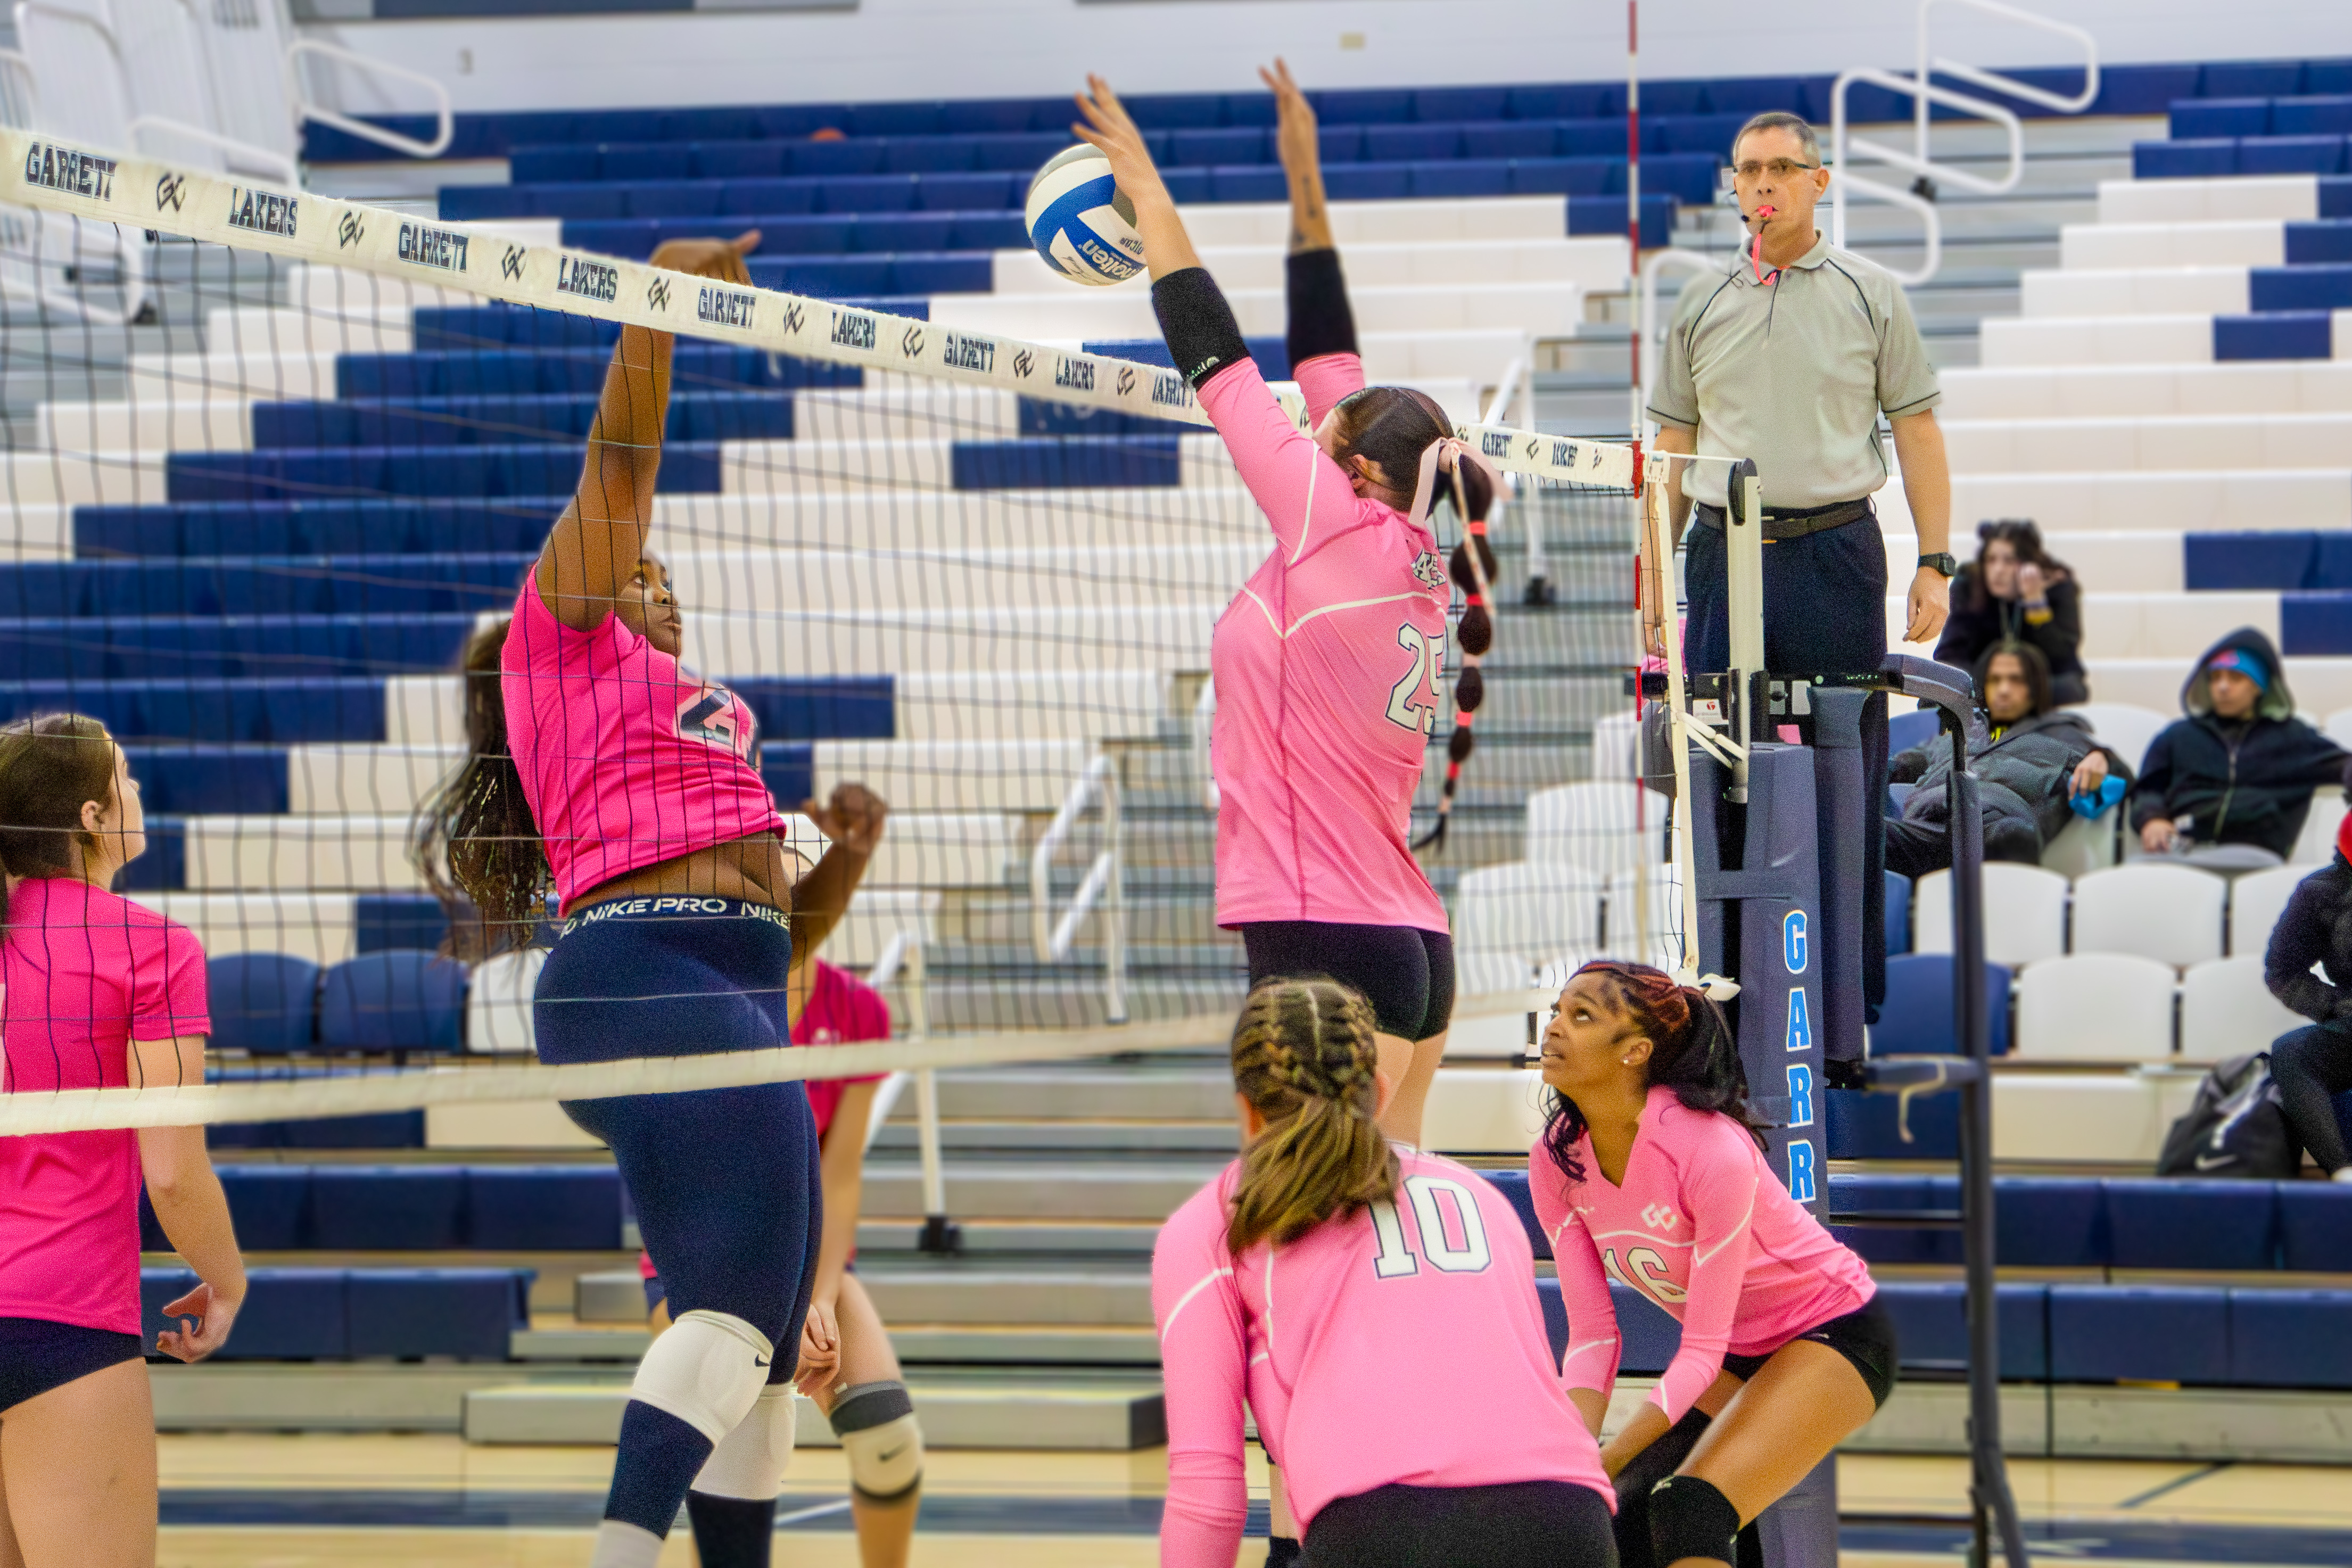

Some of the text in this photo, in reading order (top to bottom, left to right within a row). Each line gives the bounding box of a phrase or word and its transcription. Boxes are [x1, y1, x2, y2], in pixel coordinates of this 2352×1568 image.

[557, 254, 618, 303] LAKERS
[582, 898, 651, 927] NIKE
[653, 898, 727, 913] PRO
[1784, 909, 1816, 1218] GARR
[1368, 1174, 1491, 1279] 10
[1603, 1247, 1687, 1304] 16
